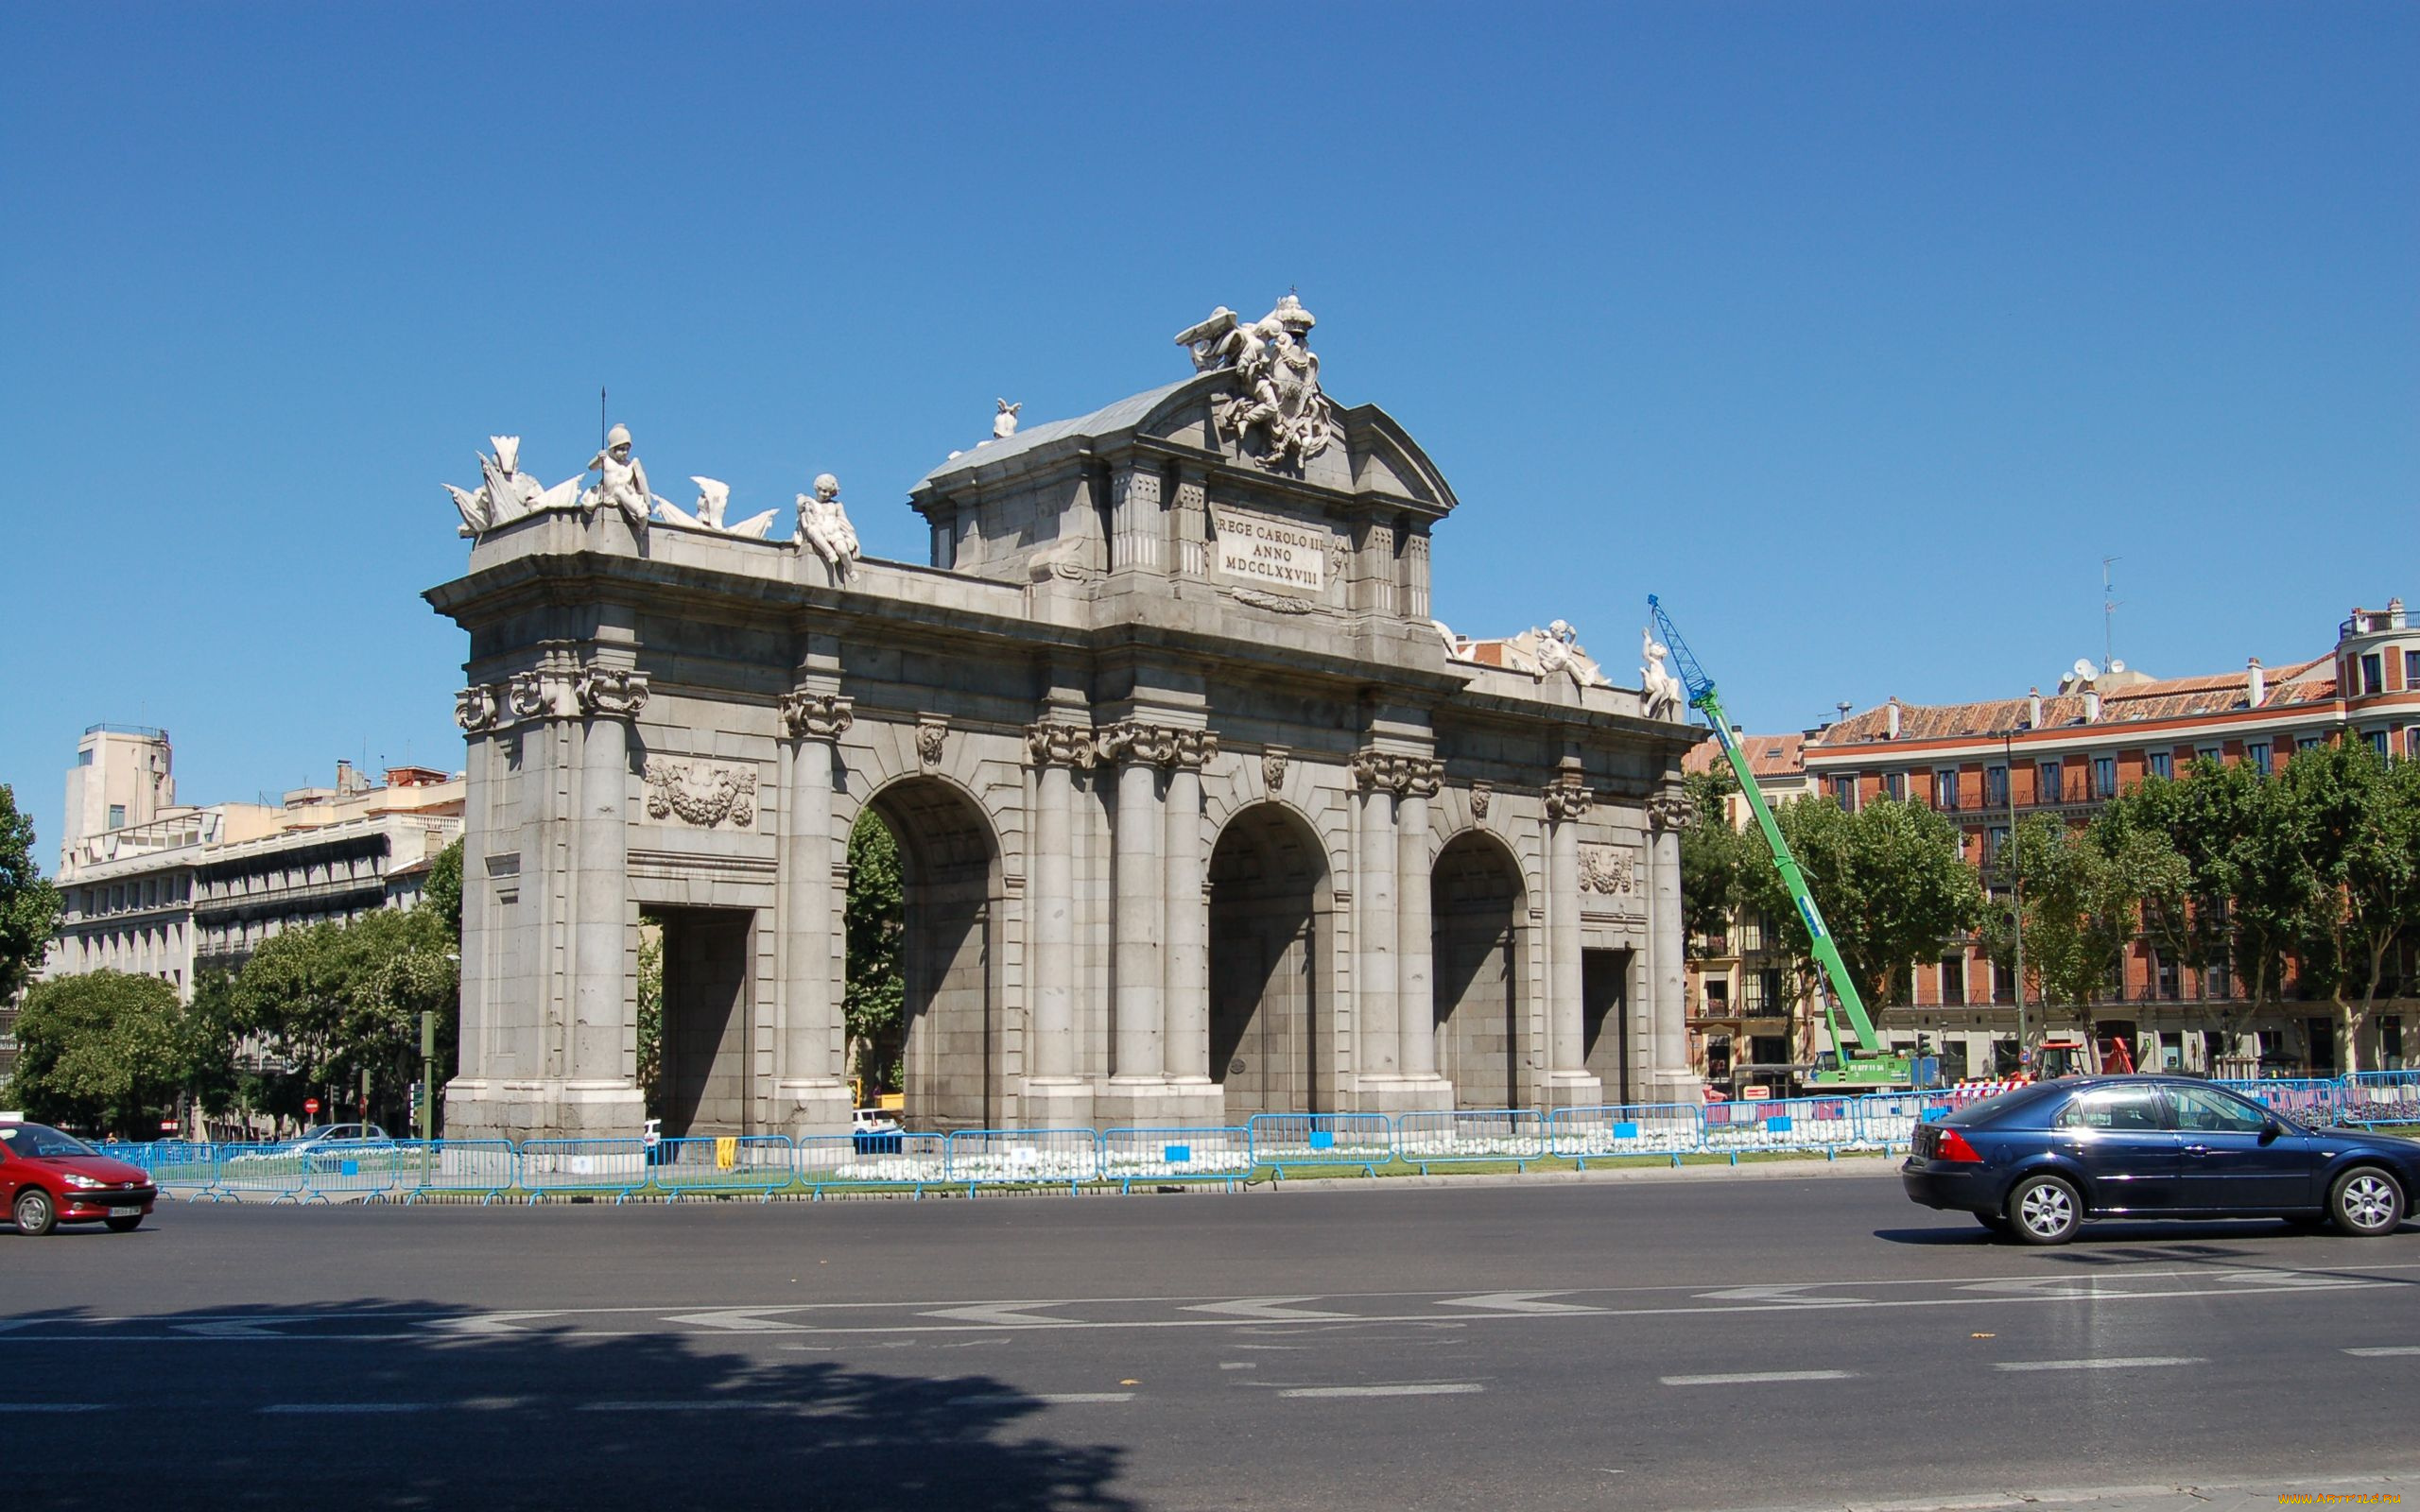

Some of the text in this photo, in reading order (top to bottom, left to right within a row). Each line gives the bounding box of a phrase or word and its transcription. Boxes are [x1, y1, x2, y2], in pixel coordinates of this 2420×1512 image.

[1218, 518, 1324, 552] REGE CAROLO III
[1253, 543, 1291, 562] ANNO
[1226, 556, 1317, 585] MDCCLXXVIII
